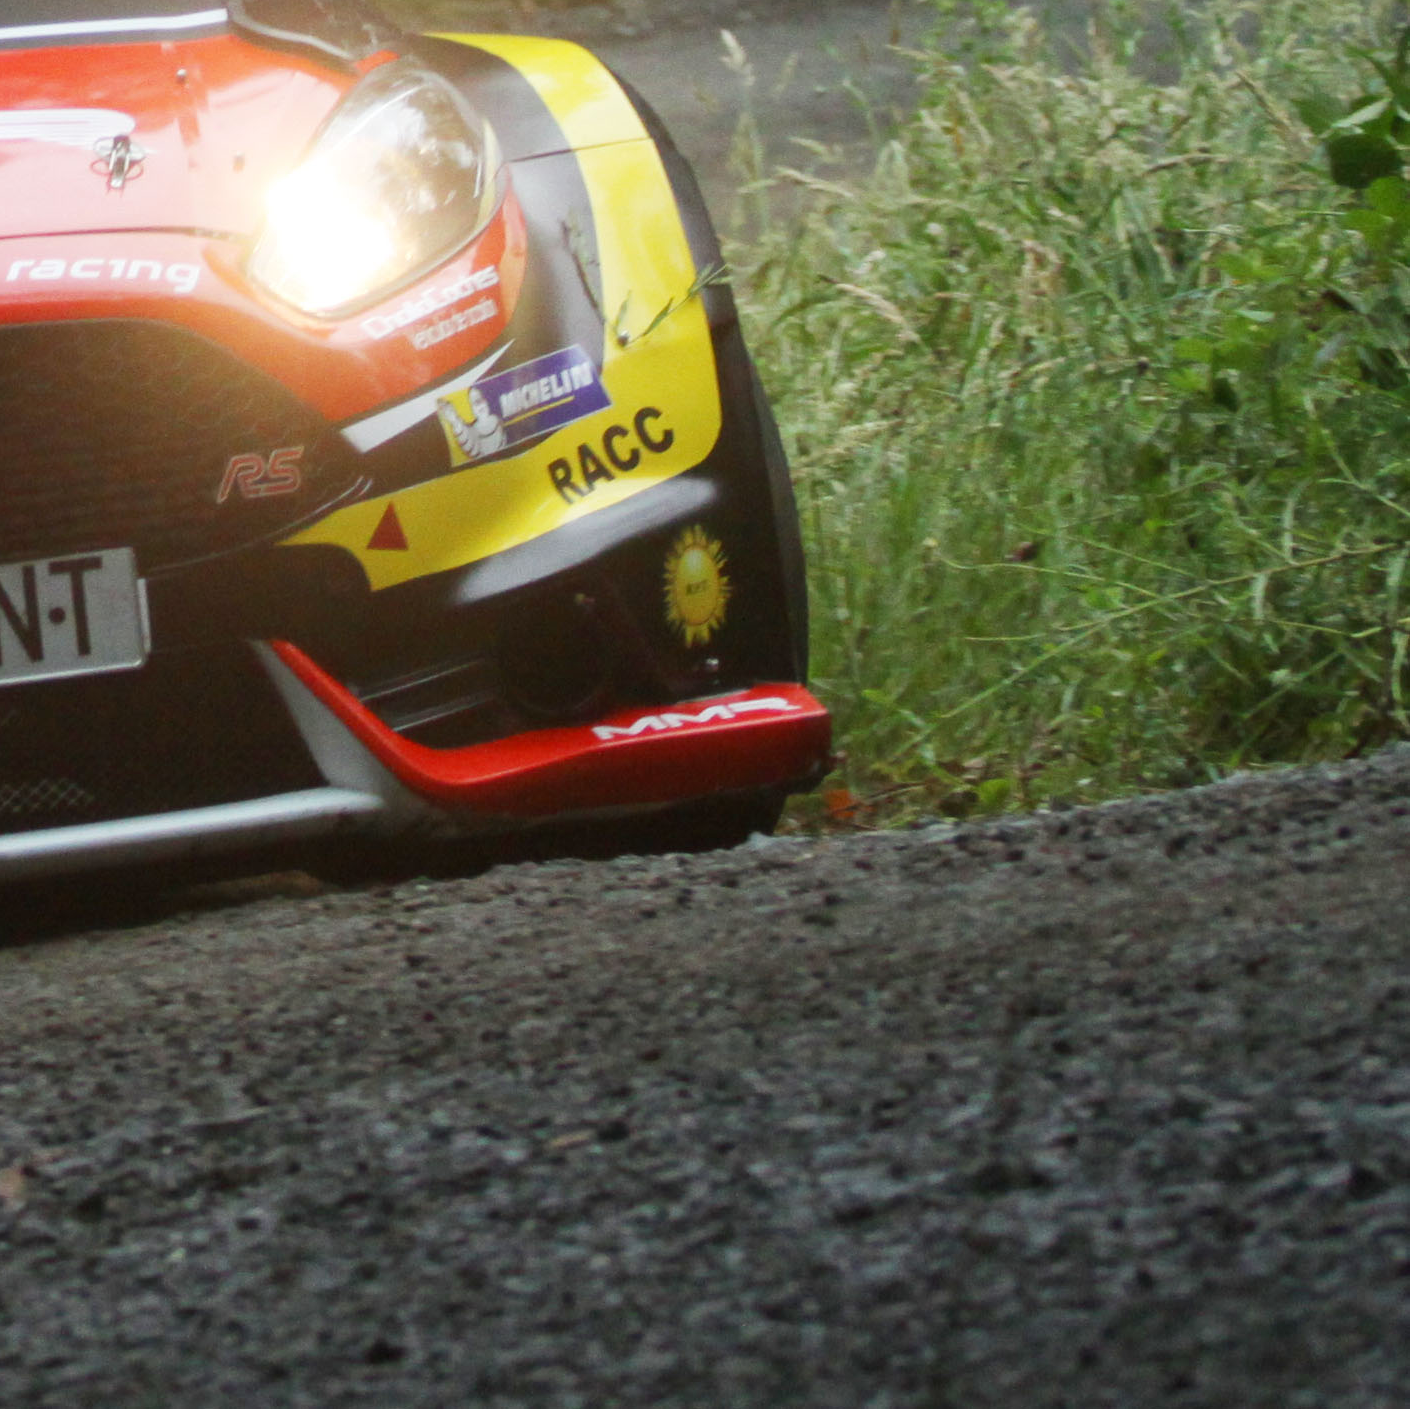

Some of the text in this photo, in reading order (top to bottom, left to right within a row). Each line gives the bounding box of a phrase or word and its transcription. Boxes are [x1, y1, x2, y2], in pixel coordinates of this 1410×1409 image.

[5, 257, 202, 294] racing
[498, 361, 594, 420] MICHELIN
[216, 446, 304, 504] RS
[546, 405, 676, 506] RACC
[591, 696, 803, 740] MMR
